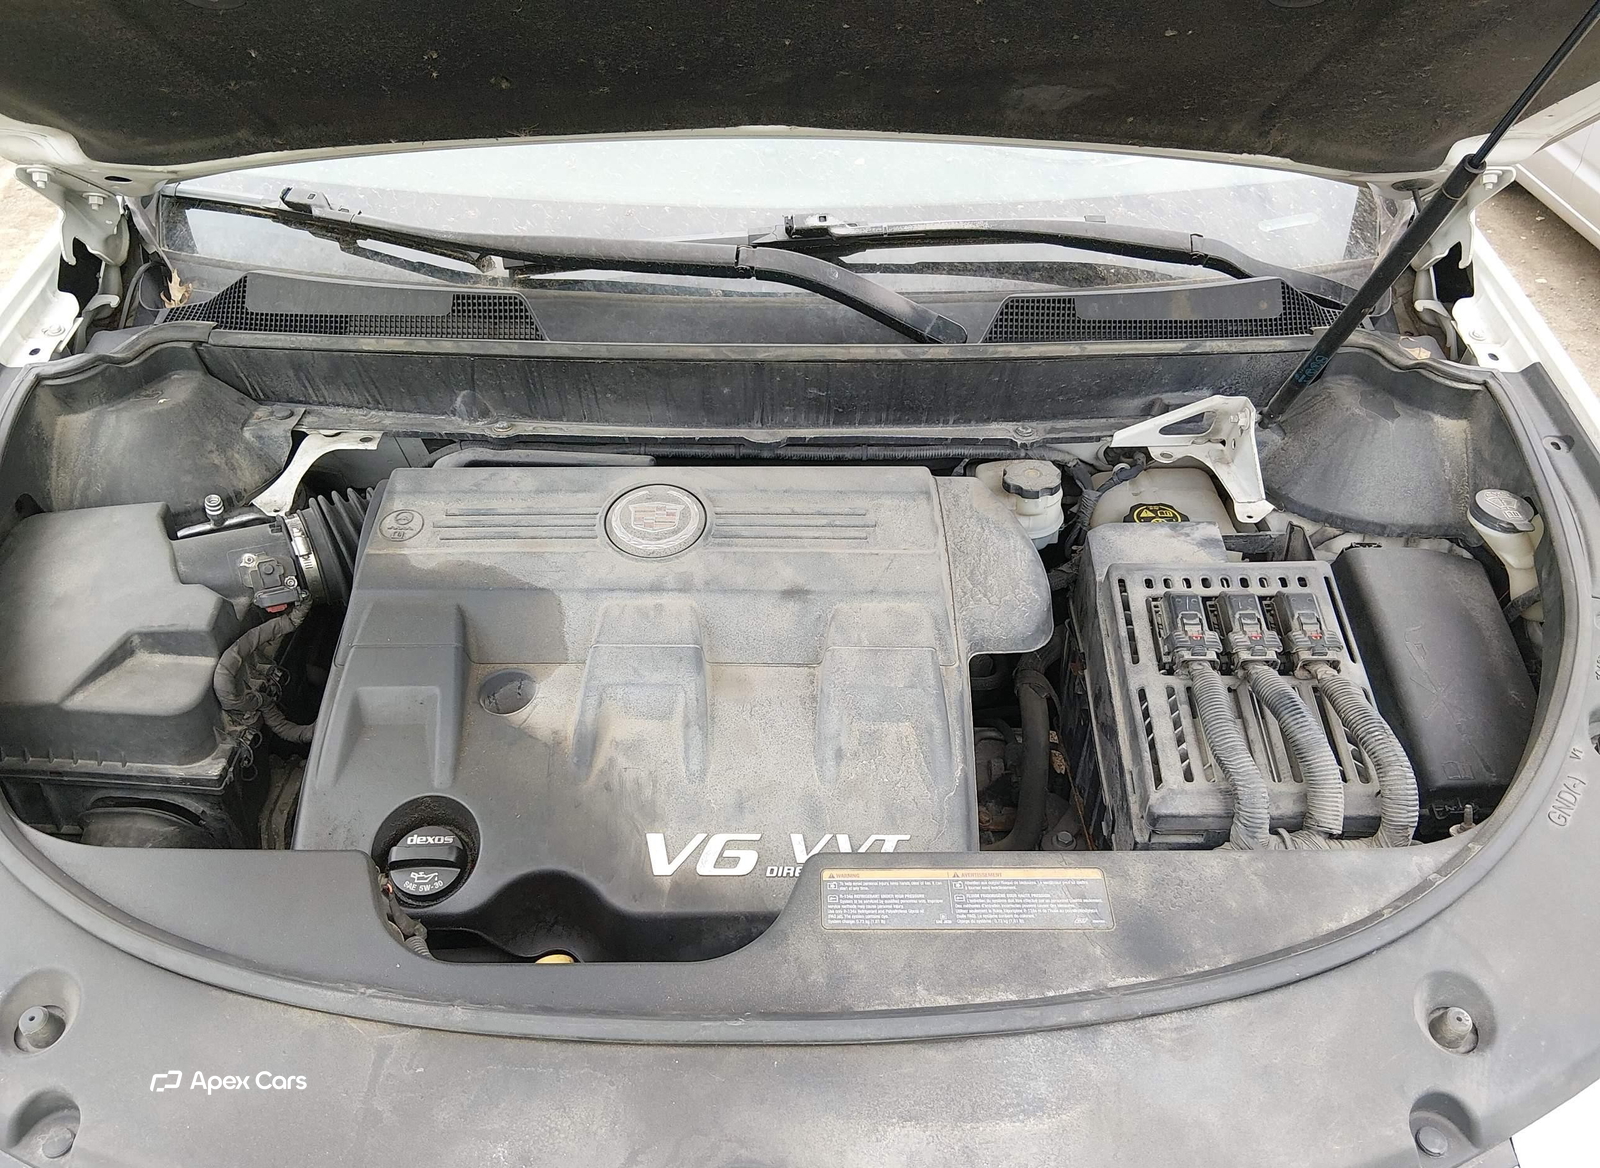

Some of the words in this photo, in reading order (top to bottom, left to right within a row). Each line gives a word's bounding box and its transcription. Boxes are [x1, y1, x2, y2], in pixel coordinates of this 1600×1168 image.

[407, 834, 455, 845] dexos
[645, 832, 763, 876] V6
[790, 833, 911, 864] VVT
[403, 880, 418, 891] SAE
[419, 880, 444, 892] 5W-30
